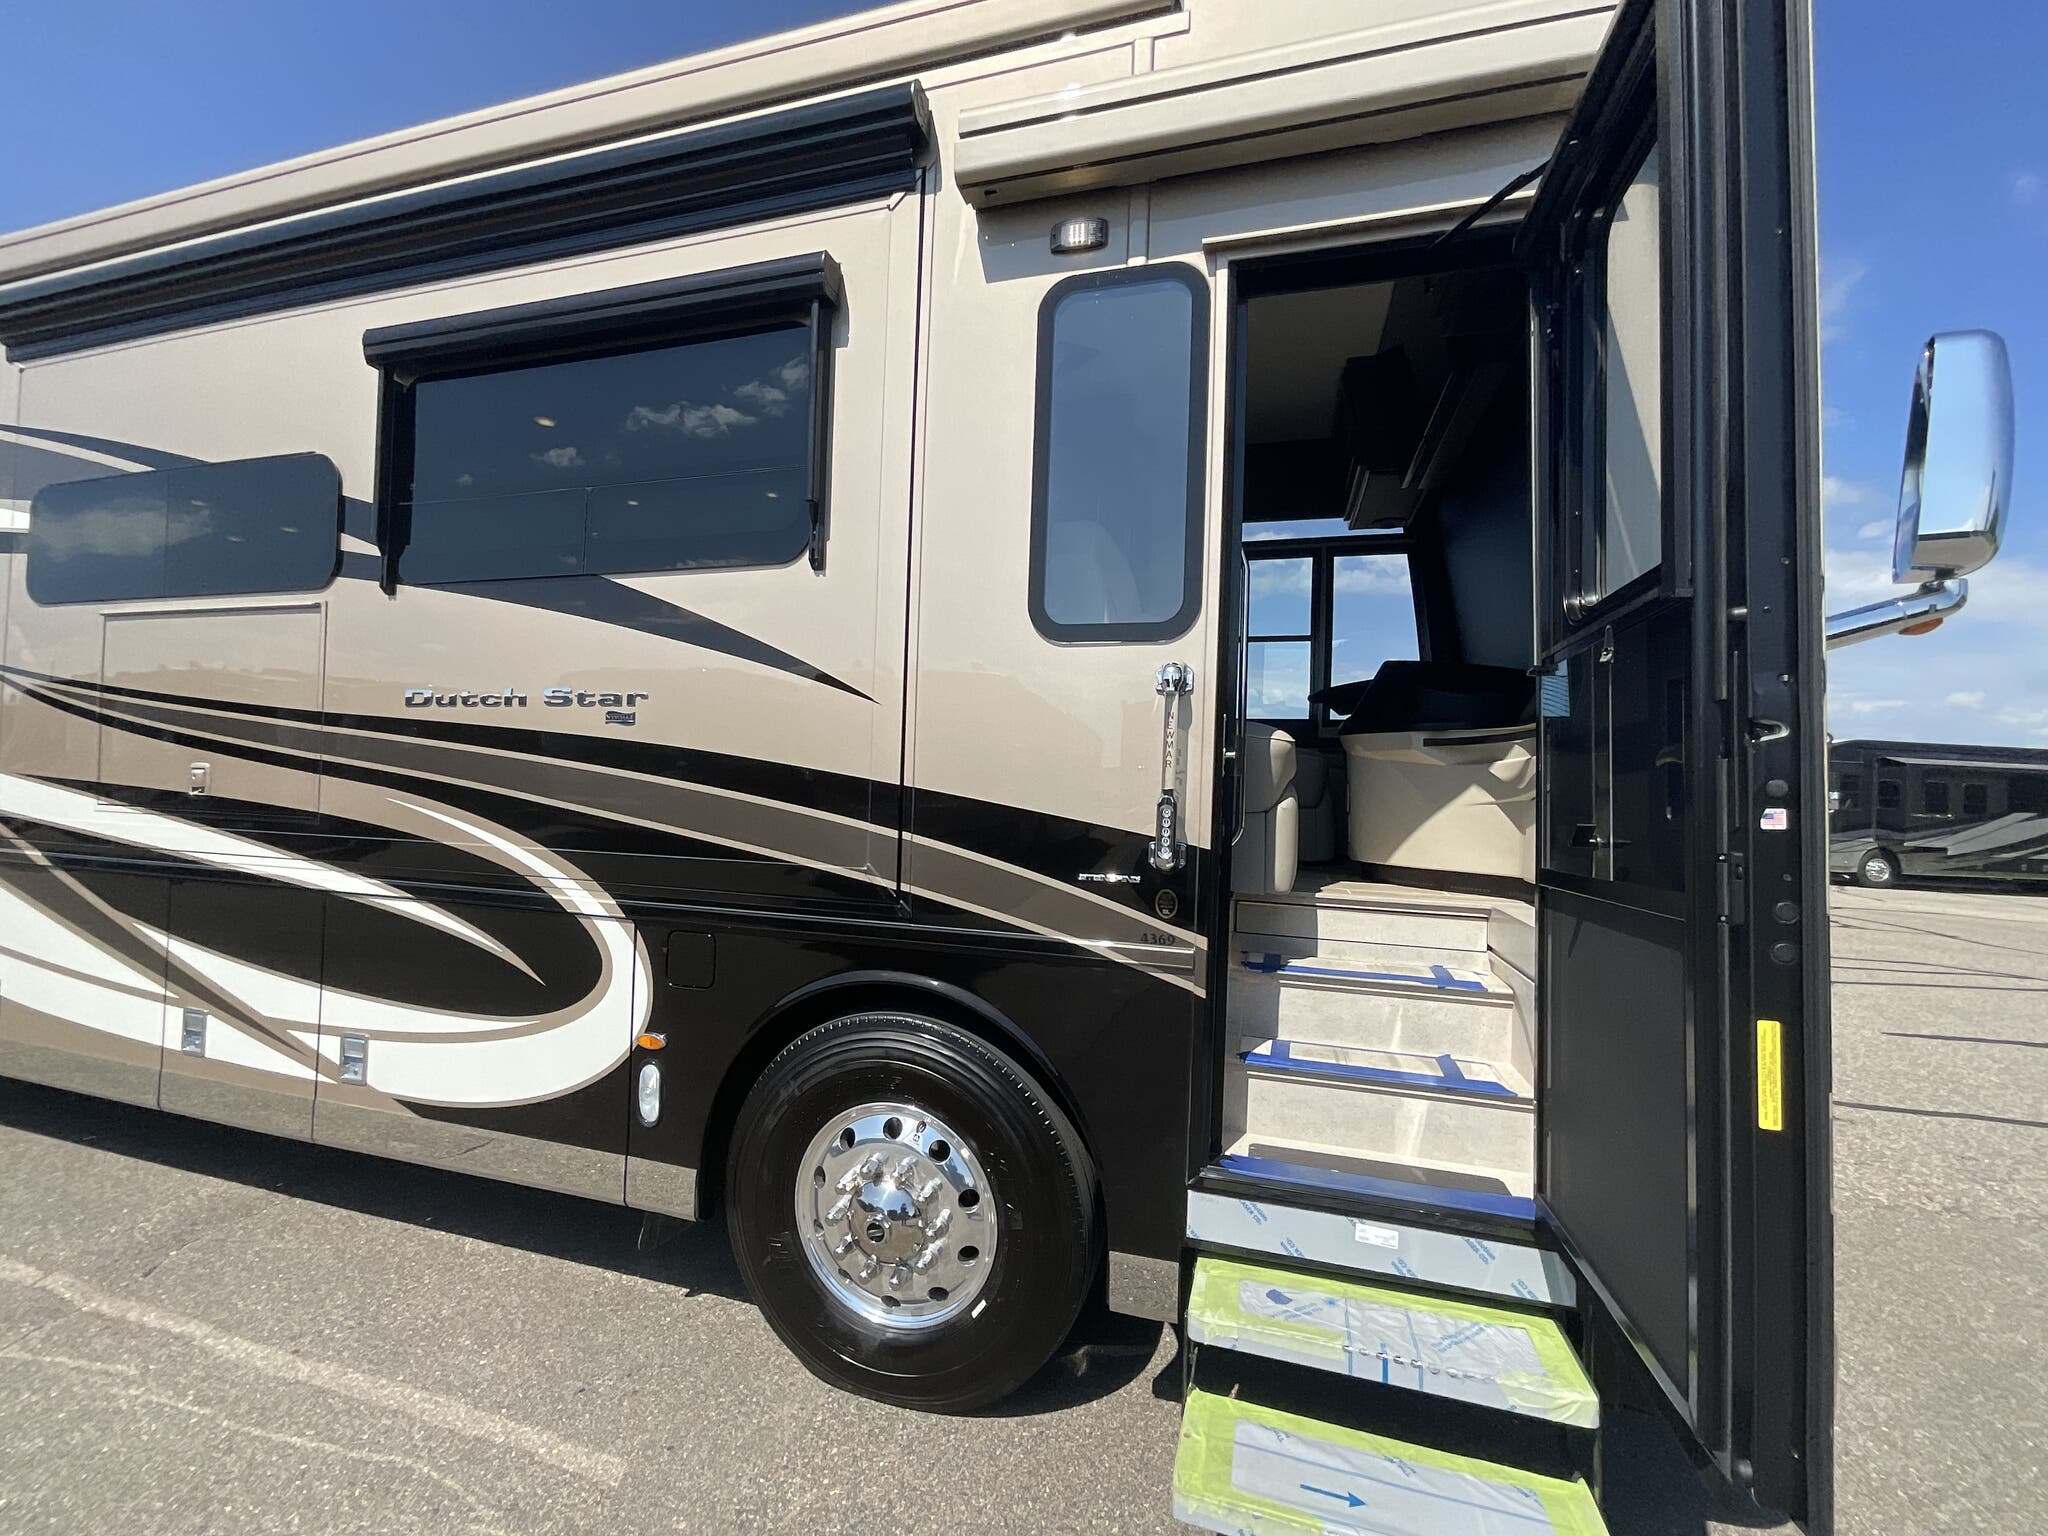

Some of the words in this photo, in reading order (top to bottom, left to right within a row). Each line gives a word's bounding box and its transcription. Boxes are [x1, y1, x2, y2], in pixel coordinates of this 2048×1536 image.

[404, 687, 528, 708] Dutch
[543, 687, 649, 708] Star
[1164, 711, 1175, 769] NEWMAR
[1140, 932, 1175, 946] 4369
